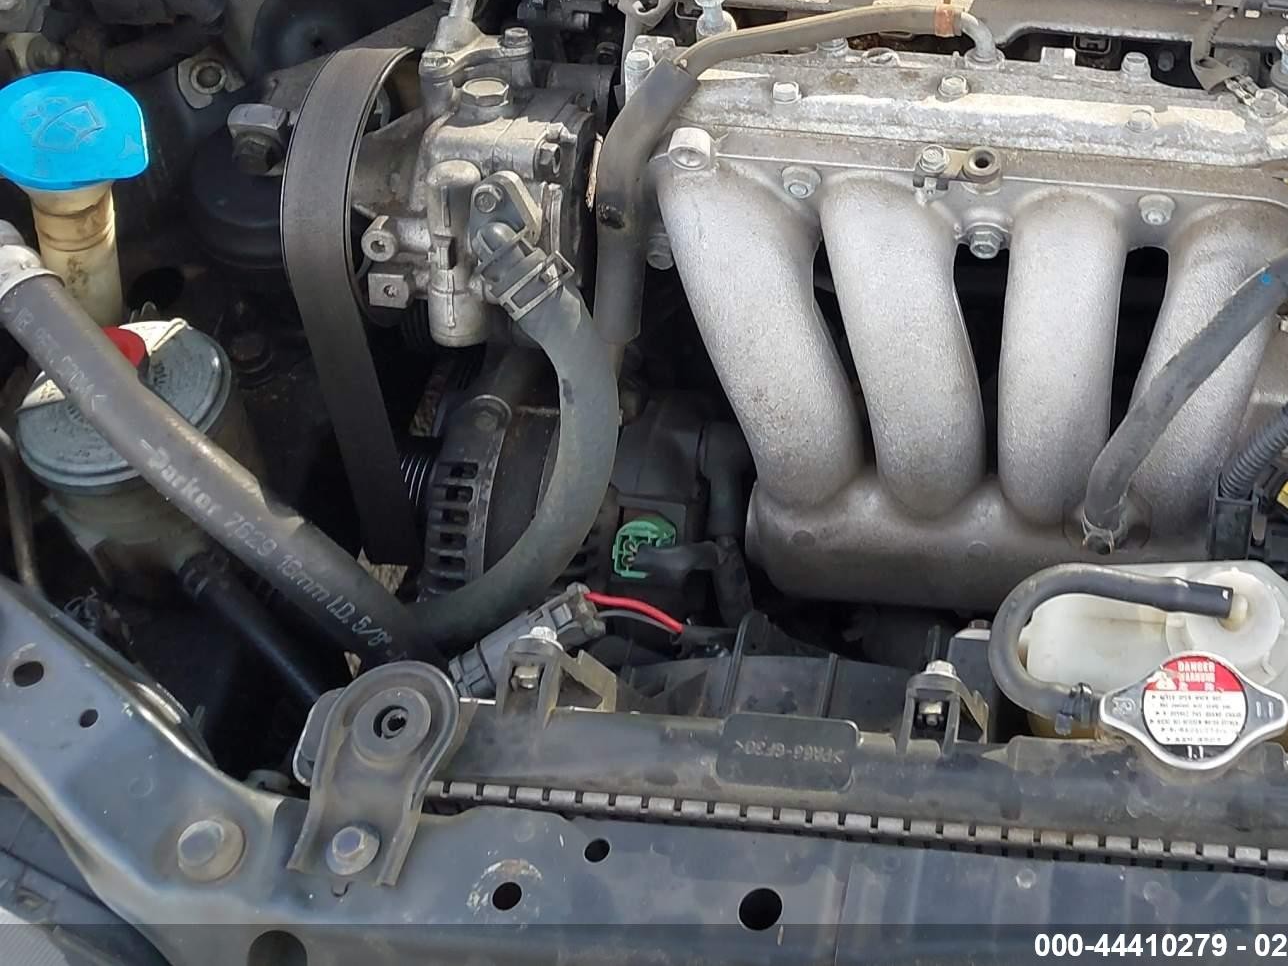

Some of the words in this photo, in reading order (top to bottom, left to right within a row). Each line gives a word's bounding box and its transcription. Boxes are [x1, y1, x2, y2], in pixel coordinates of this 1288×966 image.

[148, 437, 221, 516] Parker
[224, 511, 277, 557] 7629
[1178, 661, 1216, 673] DANGER
